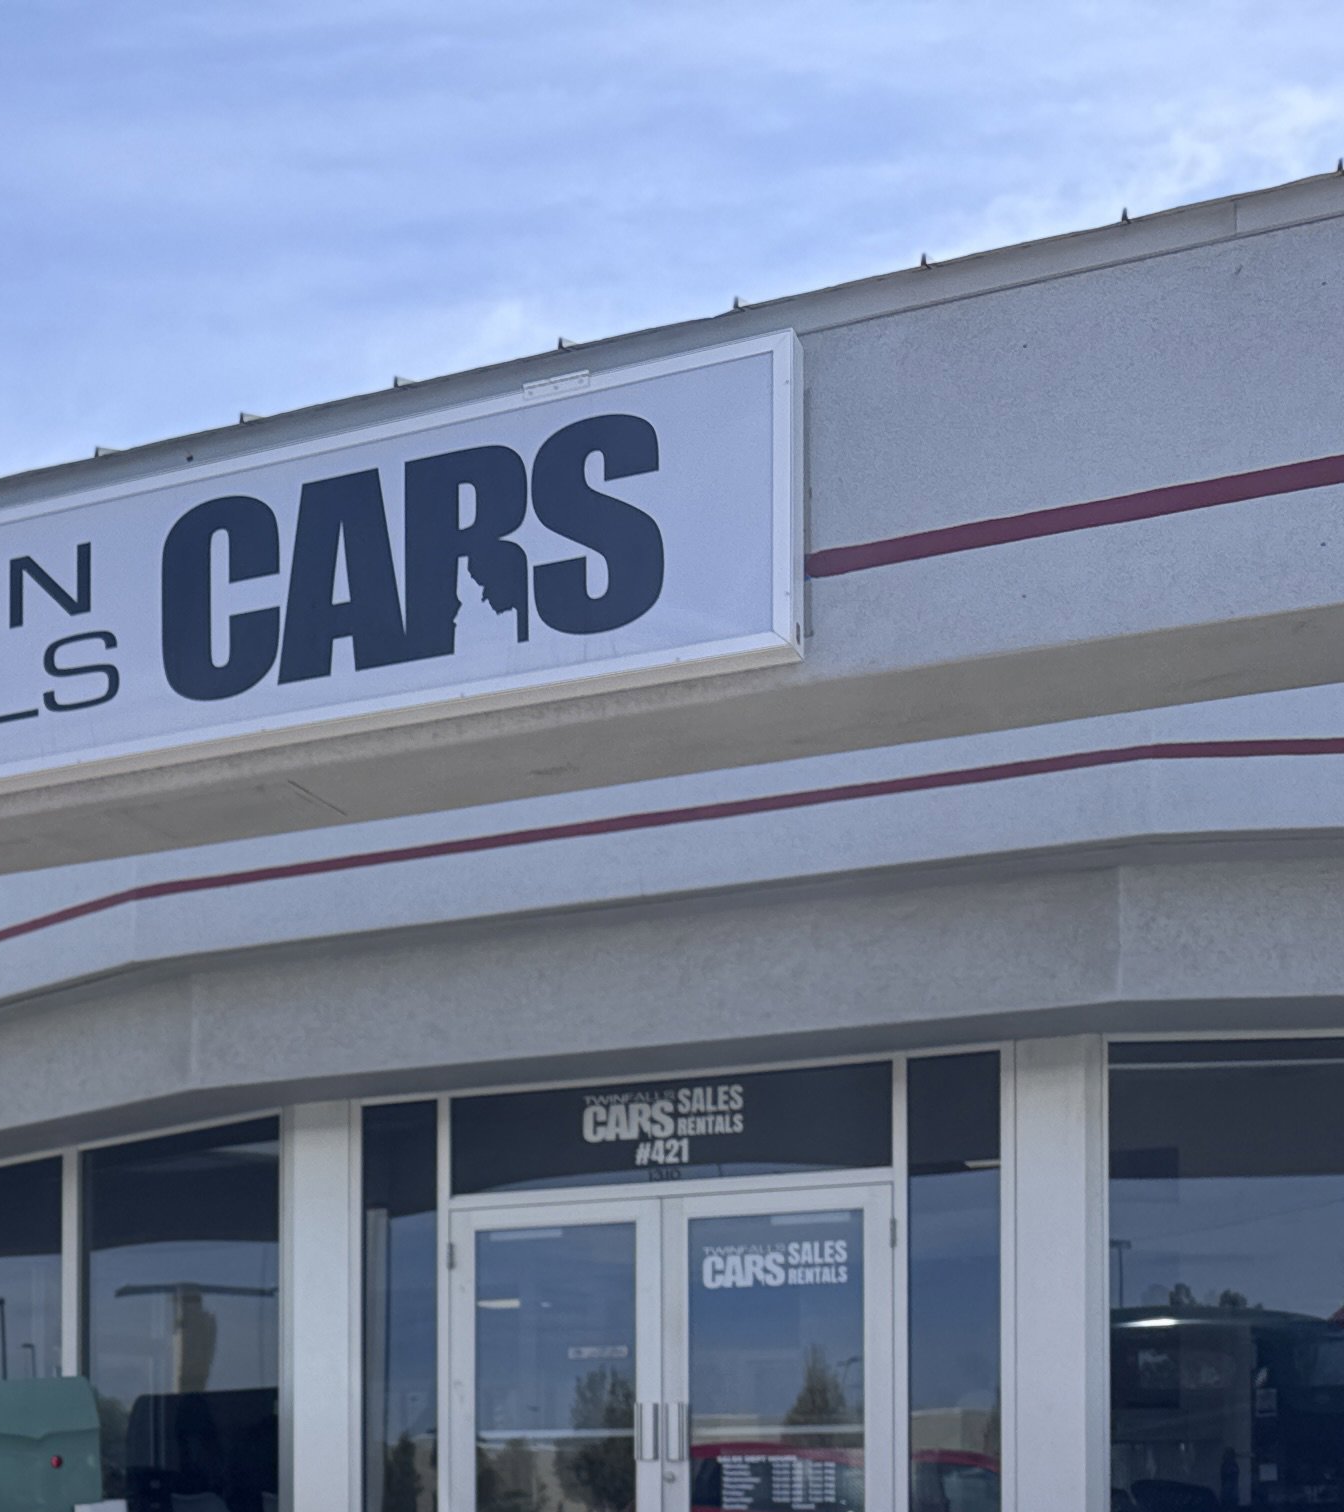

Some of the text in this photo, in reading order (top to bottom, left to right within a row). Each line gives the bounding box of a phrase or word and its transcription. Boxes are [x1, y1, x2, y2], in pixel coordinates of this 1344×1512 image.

[161, 412, 665, 702] CARS
[677, 1084, 744, 1115] SALES
[583, 1099, 675, 1143] CARS
[677, 1114, 744, 1137] RENTALS
[635, 1138, 690, 1166] #421
[787, 1240, 848, 1265] SALES
[702, 1252, 786, 1290] CARS
[787, 1265, 848, 1285] RENTALS
